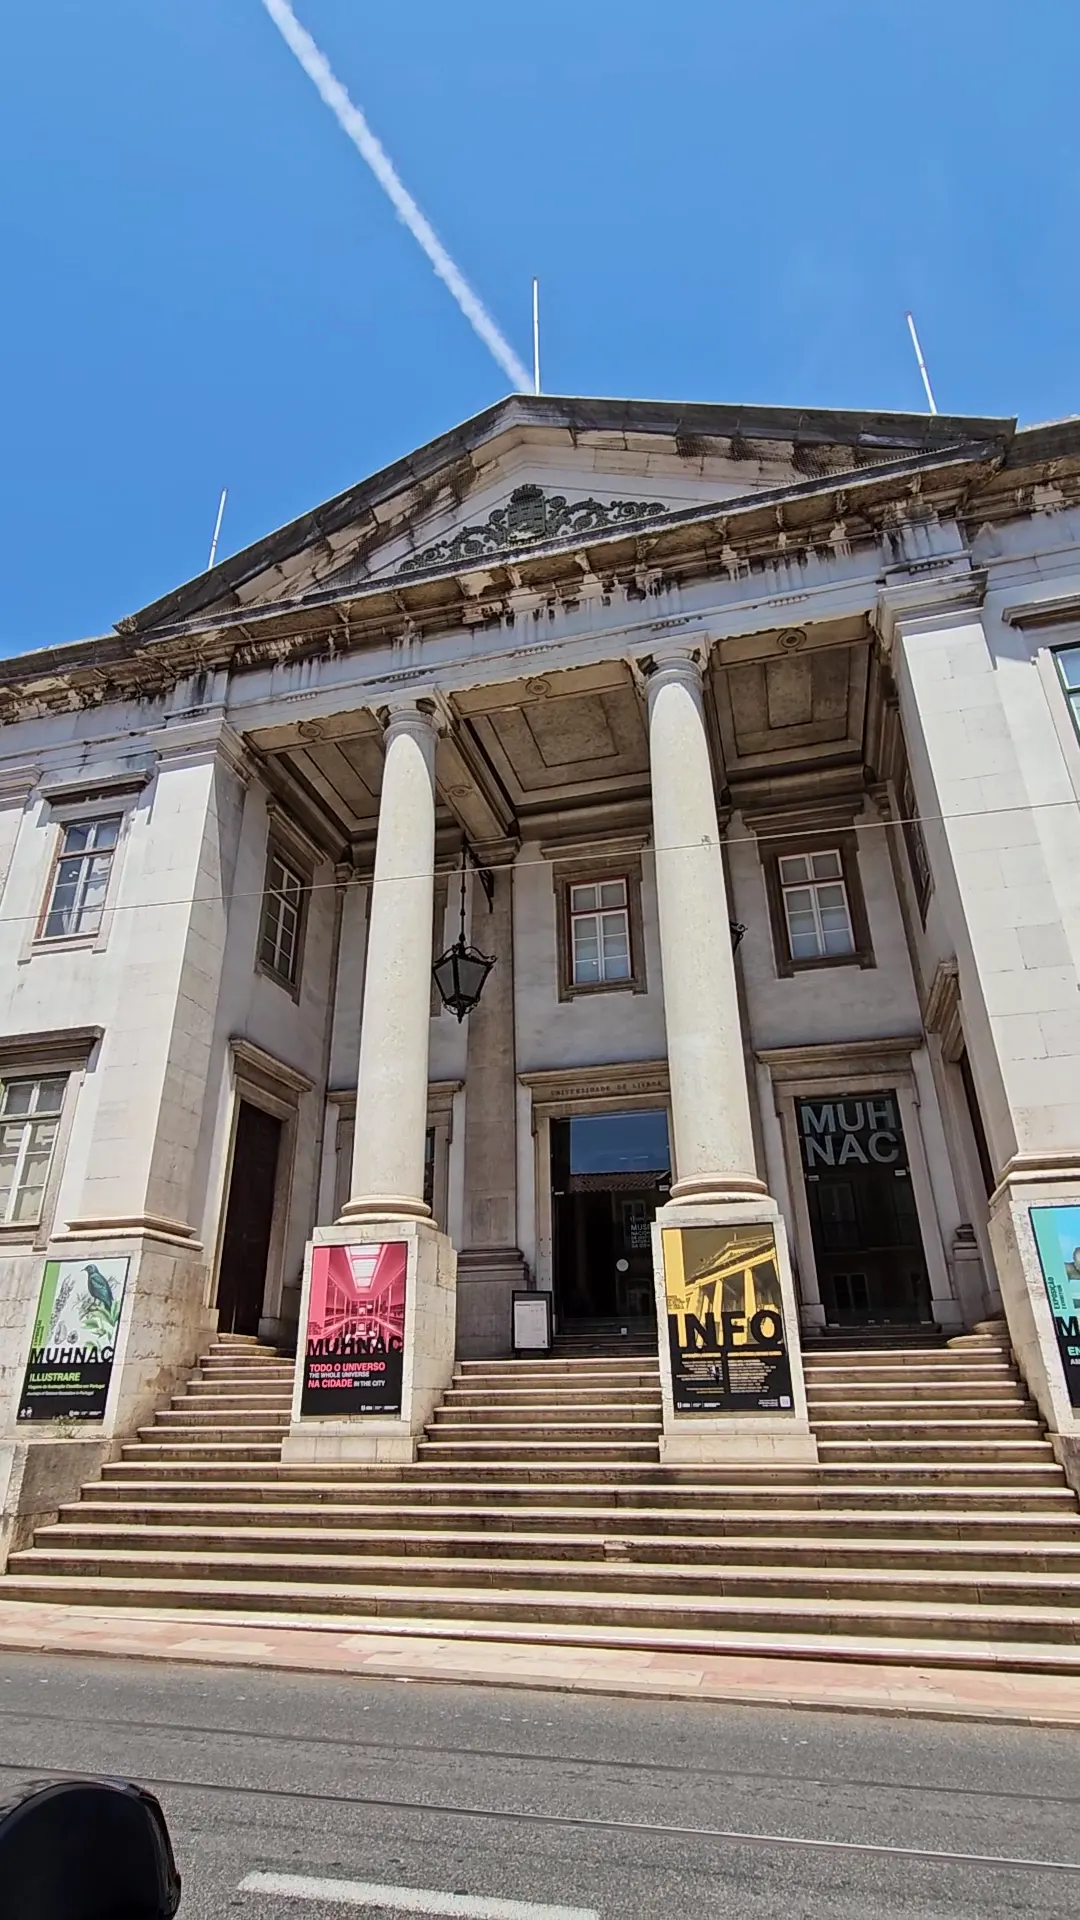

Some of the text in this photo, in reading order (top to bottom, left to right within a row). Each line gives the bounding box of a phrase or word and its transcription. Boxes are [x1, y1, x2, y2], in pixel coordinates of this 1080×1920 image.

[551, 1080, 662, 1097] UNIVERSIDADE DE LISBOA
[801, 1100, 897, 1134] MUH
[804, 1131, 900, 1167] NAC
[668, 1310, 784, 1347] INFO
[29, 1346, 114, 1364] MUHNAC
[307, 1336, 403, 1356] MUHNAC
[310, 1362, 386, 1373] TODO O UNIVERSO
[29, 1372, 81, 1383] ILLUSTRARE
[308, 1379, 320, 1389] NA
[321, 1378, 353, 1388] CIDADE
